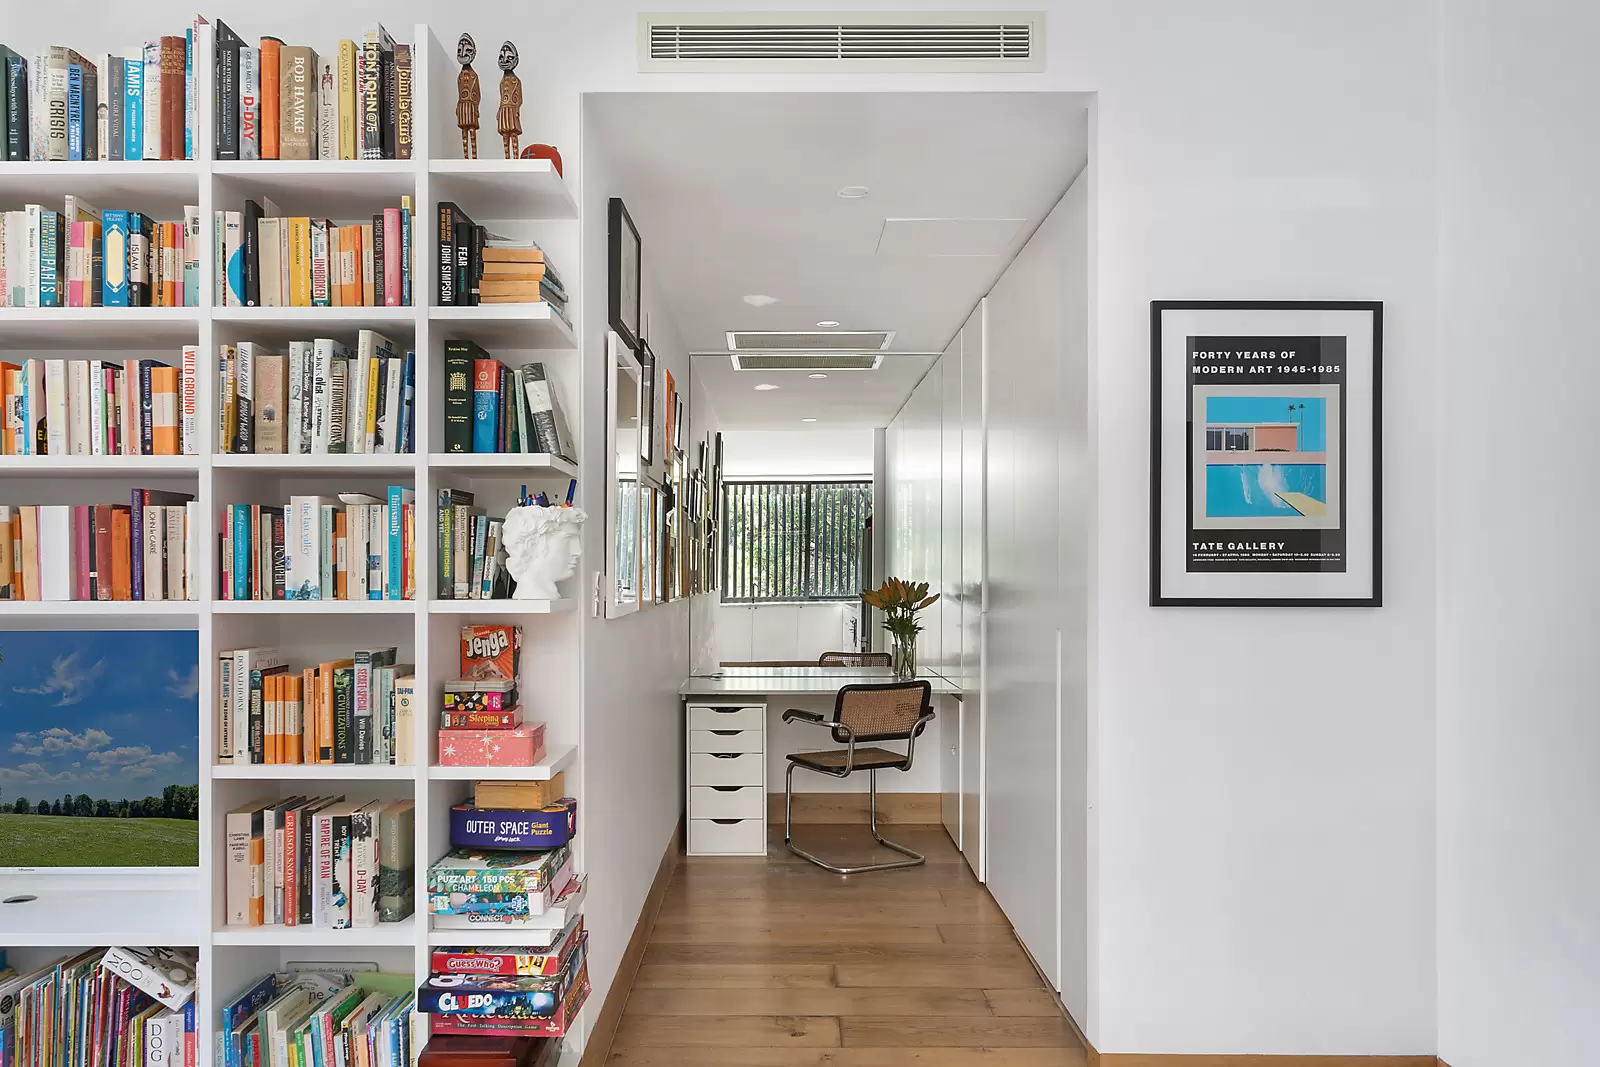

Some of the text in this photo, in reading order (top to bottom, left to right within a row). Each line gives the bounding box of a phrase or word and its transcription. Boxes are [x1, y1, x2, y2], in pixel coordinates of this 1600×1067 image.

[9, 64, 18, 96] Wednesdays
[366, 76, 376, 112] JOHN
[396, 66, 410, 96] John
[70, 68, 80, 122] BEN MACINTYRE
[294, 56, 304, 134] BOB HAWKE
[398, 96, 410, 110] le
[50, 100, 65, 139] CRISIS
[244, 96, 254, 141] D-DAY
[366, 112, 376, 132] @75
[322, 118, 330, 158] ANARCHY
[458, 246, 468, 266] FEAR
[41, 258, 56, 293] PARIS
[314, 258, 326, 299] UNBROKEN
[442, 244, 452, 302] JOHN SIMPSON
[1192, 351, 1296, 359] FORTY YEARS OF
[1249, 366, 1273, 374] ART
[1277, 365, 1340, 373] 1945-1985
[184, 350, 196, 415] WILD GROUND
[316, 377, 327, 394] OVER
[332, 375, 344, 423] THE HONORARY
[240, 422, 248, 440] WOOD
[302, 502, 312, 556] the last valley
[390, 494, 400, 536] thinsanity
[1227, 542, 1285, 550] GALLERY
[274, 546, 284, 585] POMPEII
[466, 629, 509, 658] Jenga
[358, 668, 367, 712] SECRET SPECIAL
[337, 694, 346, 749] CIVILIZATIONS
[468, 714, 499, 726] Sleeping
[320, 818, 330, 847] EMPIRE
[466, 820, 529, 835] OUTER SPACE
[320, 850, 330, 858] OF
[320, 860, 330, 879] PAIN
[356, 870, 366, 894] D-DAY
[469, 914, 504, 923] CONNECT
[107, 953, 143, 980] MOO
[475, 960, 502, 969] Who?
[438, 992, 493, 1012] CLUEDO
[150, 1024, 162, 1062] DOG
